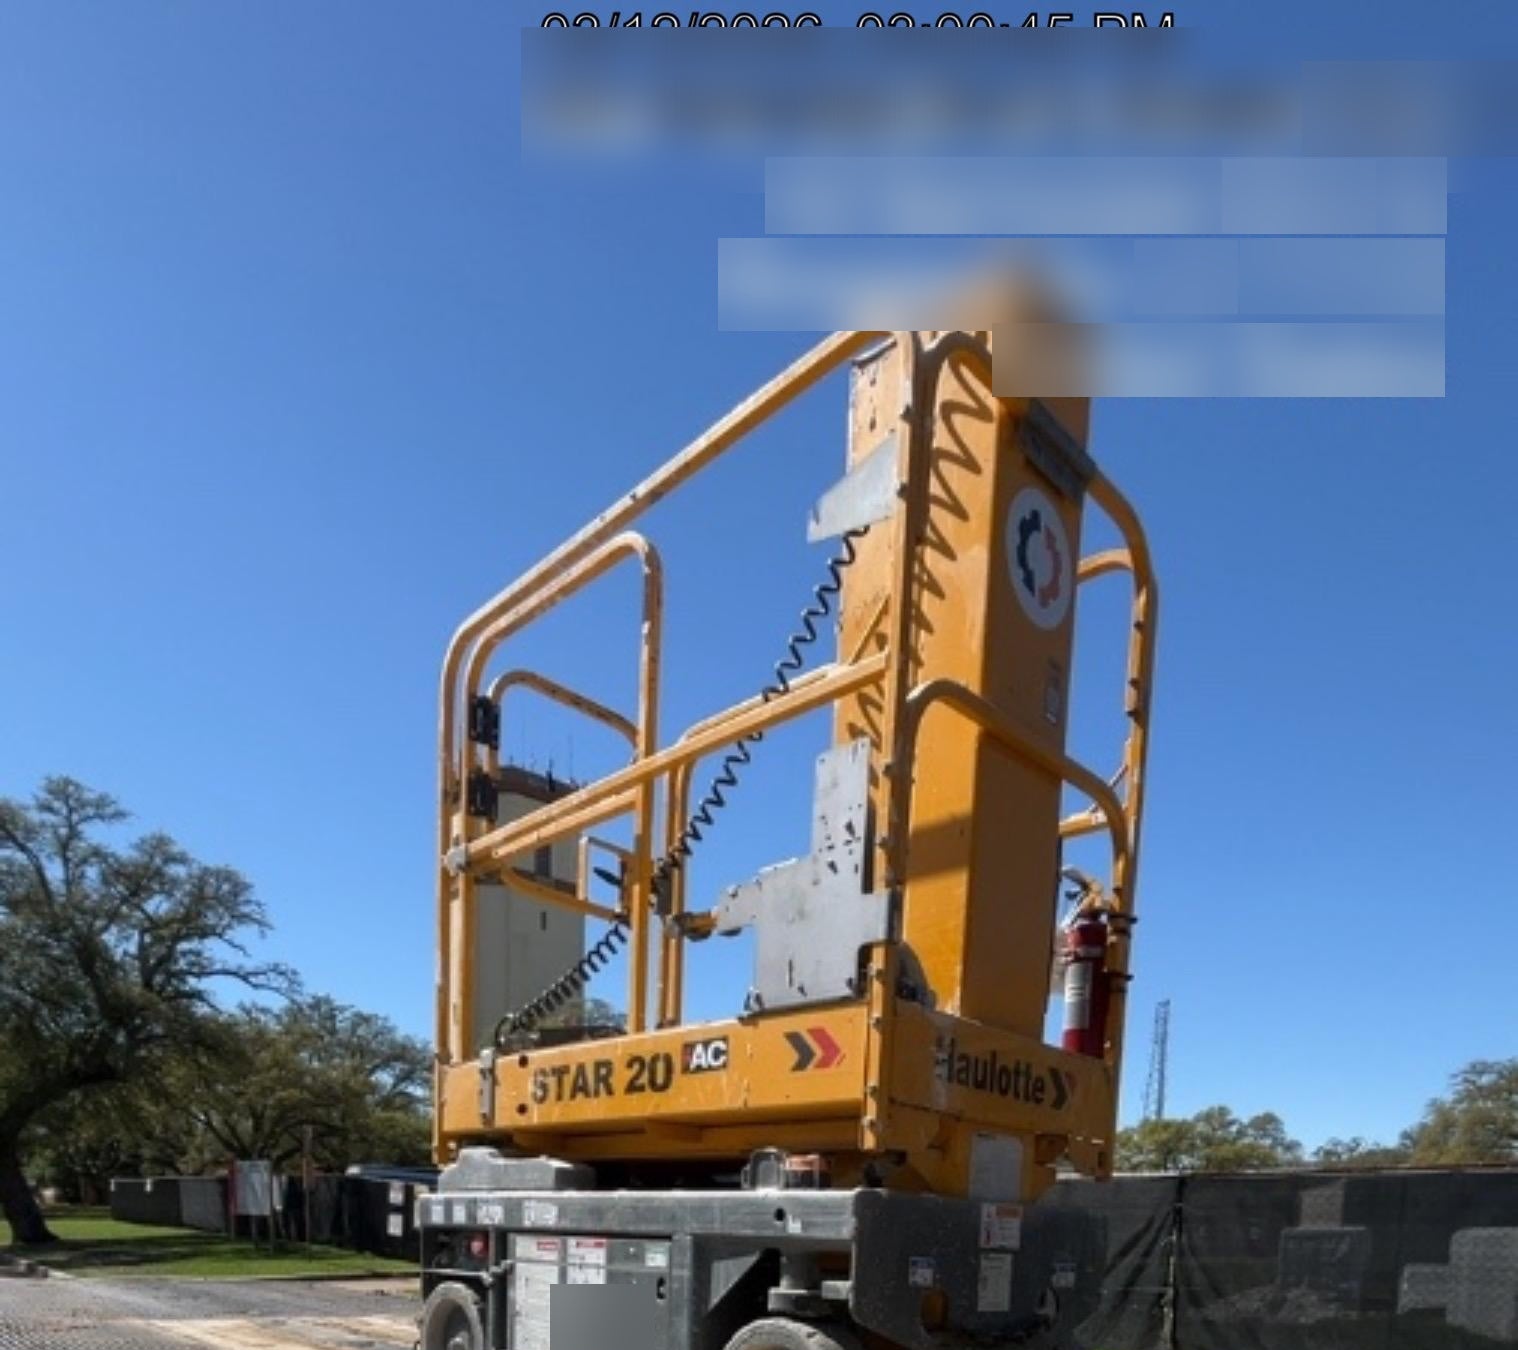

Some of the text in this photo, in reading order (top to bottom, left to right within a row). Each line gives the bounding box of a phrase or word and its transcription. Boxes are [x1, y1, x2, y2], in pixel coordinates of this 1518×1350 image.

[532, 1039, 728, 1105] STAR 20 AC
